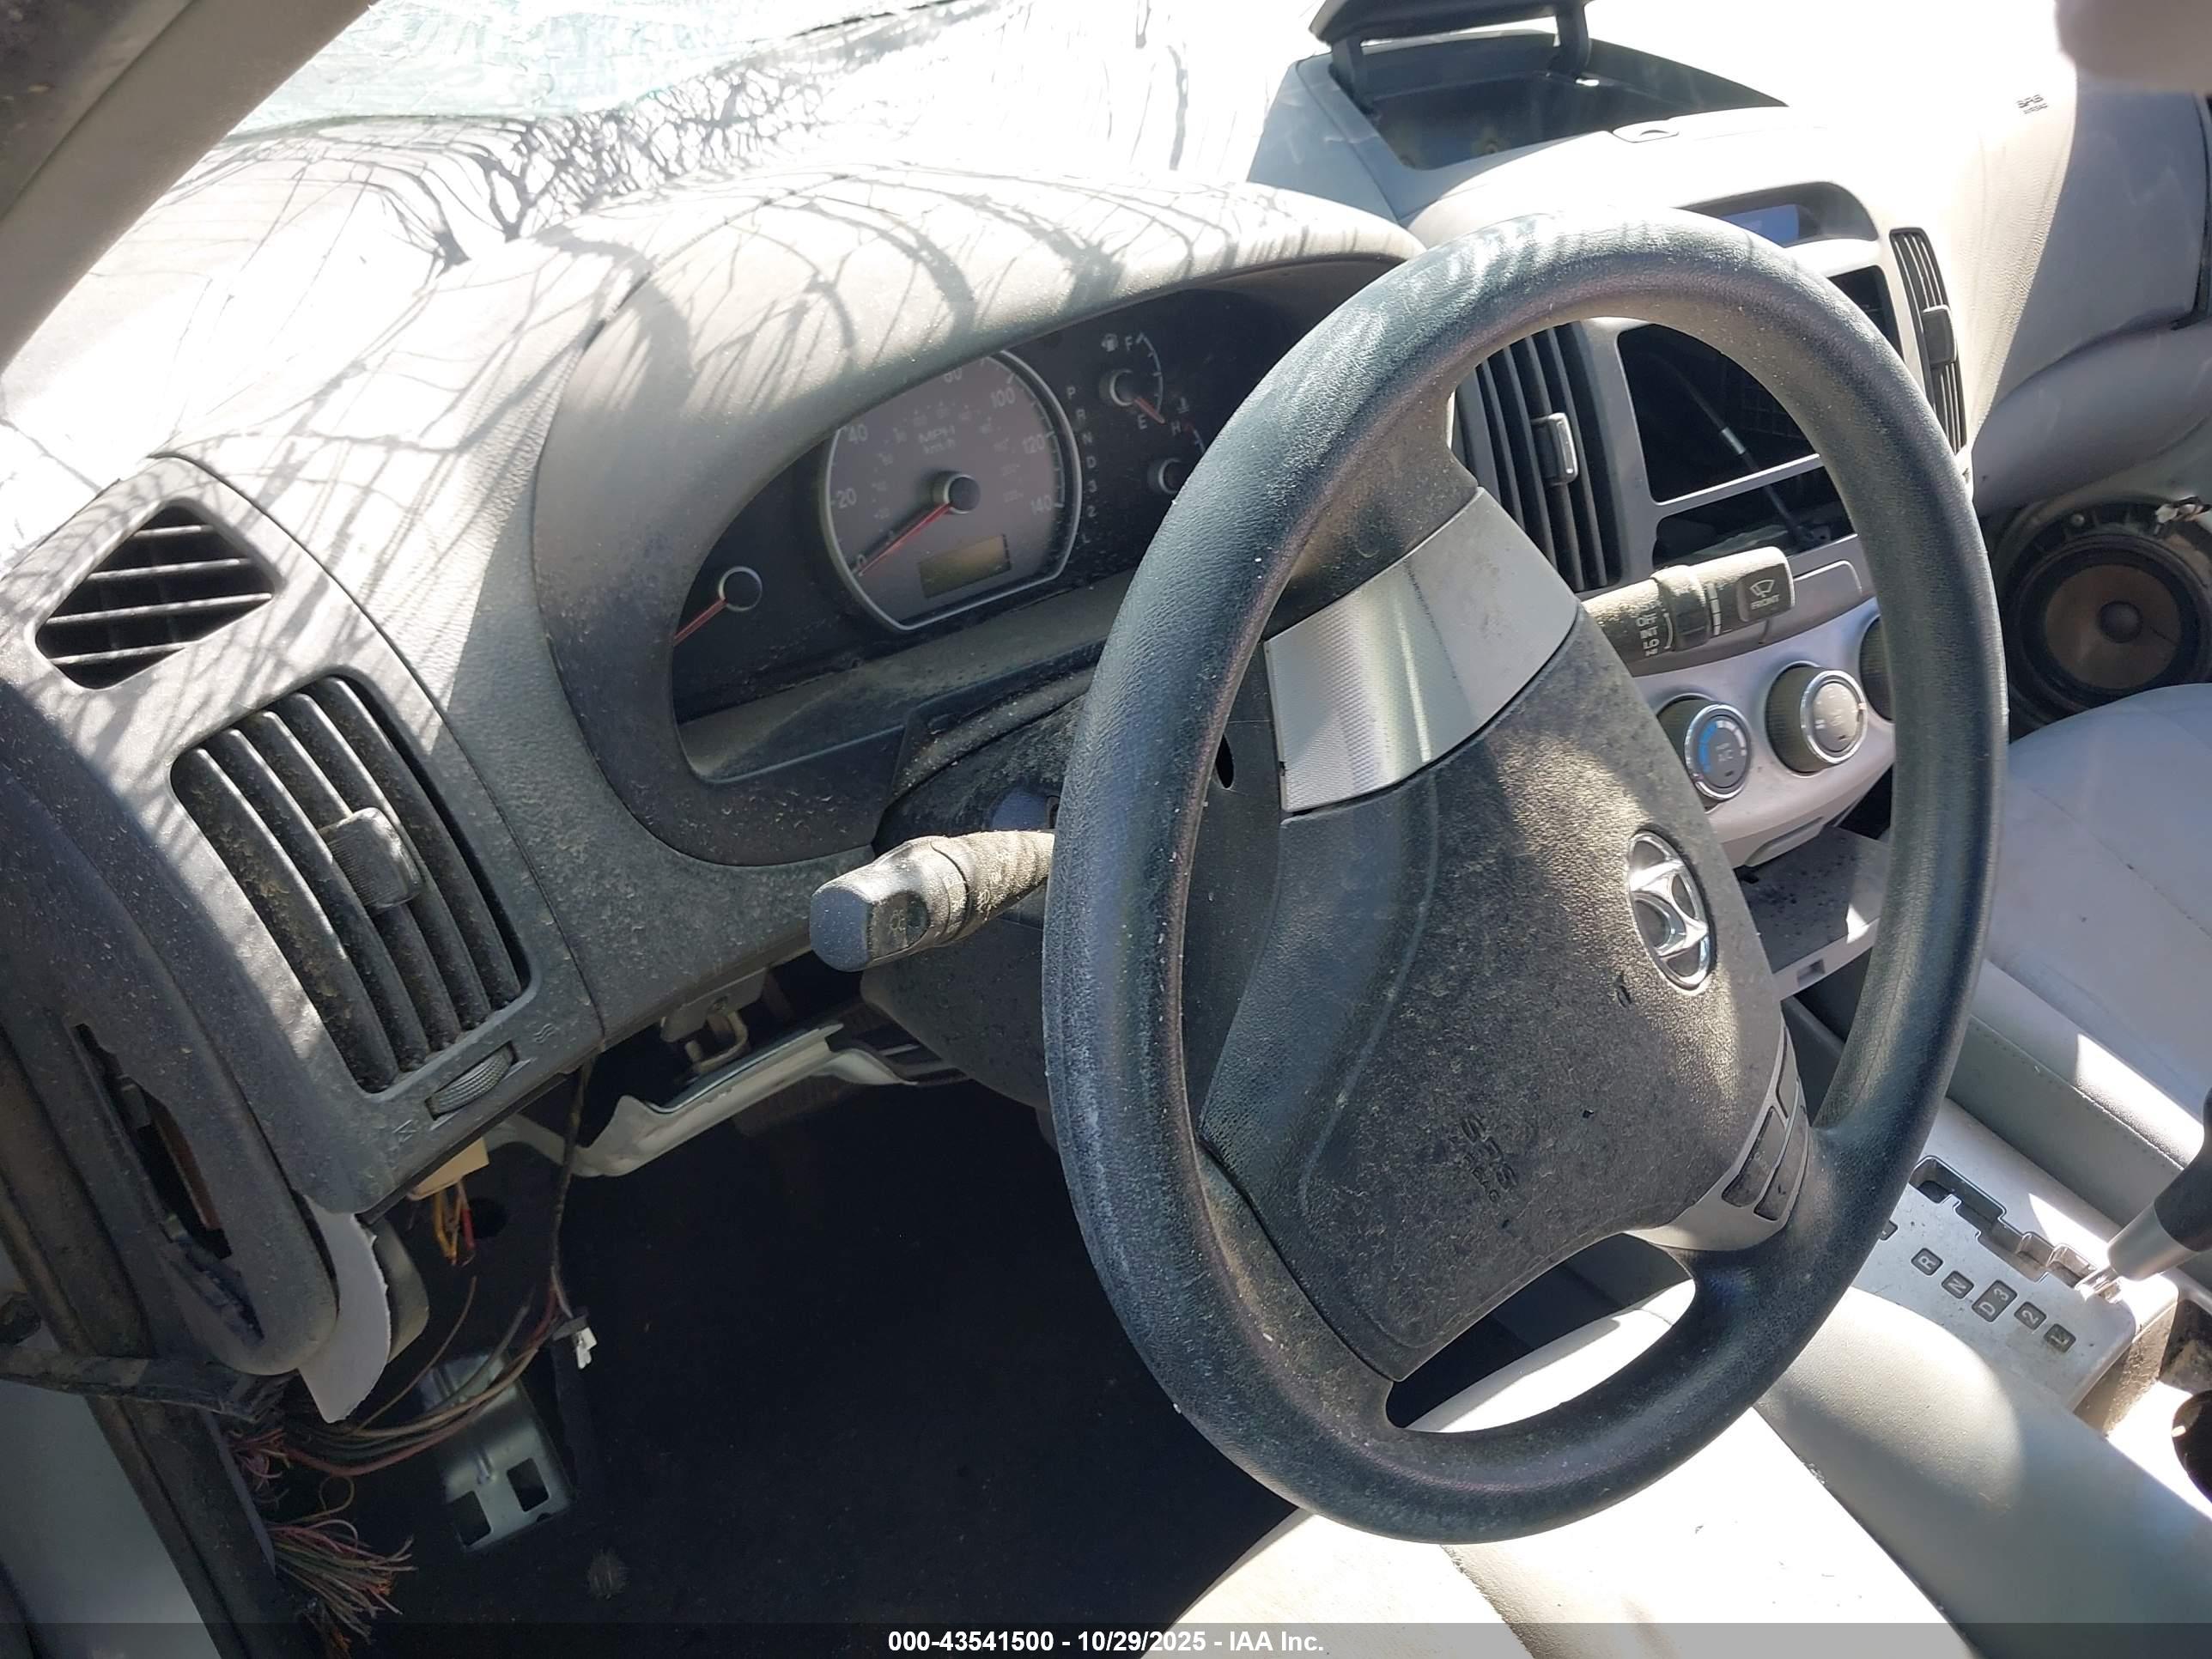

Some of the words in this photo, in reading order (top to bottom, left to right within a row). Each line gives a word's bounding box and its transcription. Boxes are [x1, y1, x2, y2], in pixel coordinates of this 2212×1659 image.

[1125, 336, 1133, 351] F
[990, 388, 1016, 409] 100
[1066, 386, 1076, 400] P
[1076, 409, 1086, 420] R
[1138, 415, 1148, 429] E
[848, 424, 869, 444] 40
[1170, 421, 1182, 435] H
[1023, 434, 1046, 454] 120
[1082, 431, 1093, 445] N
[1086, 456, 1097, 469] D
[1089, 480, 1097, 493] 3
[836, 487, 857, 508] 20
[1030, 495, 1052, 515] 140
[1087, 505, 1097, 518] 2
[1751, 594, 1779, 610] FRONT
[1917, 1255, 1937, 1271] R
[1948, 1279, 1966, 1294] N
[1994, 1288, 2010, 1302] 3
[1978, 1301, 1996, 1316] D
[2022, 1310, 2039, 1325] 2
[2050, 1334, 2069, 1346] L
